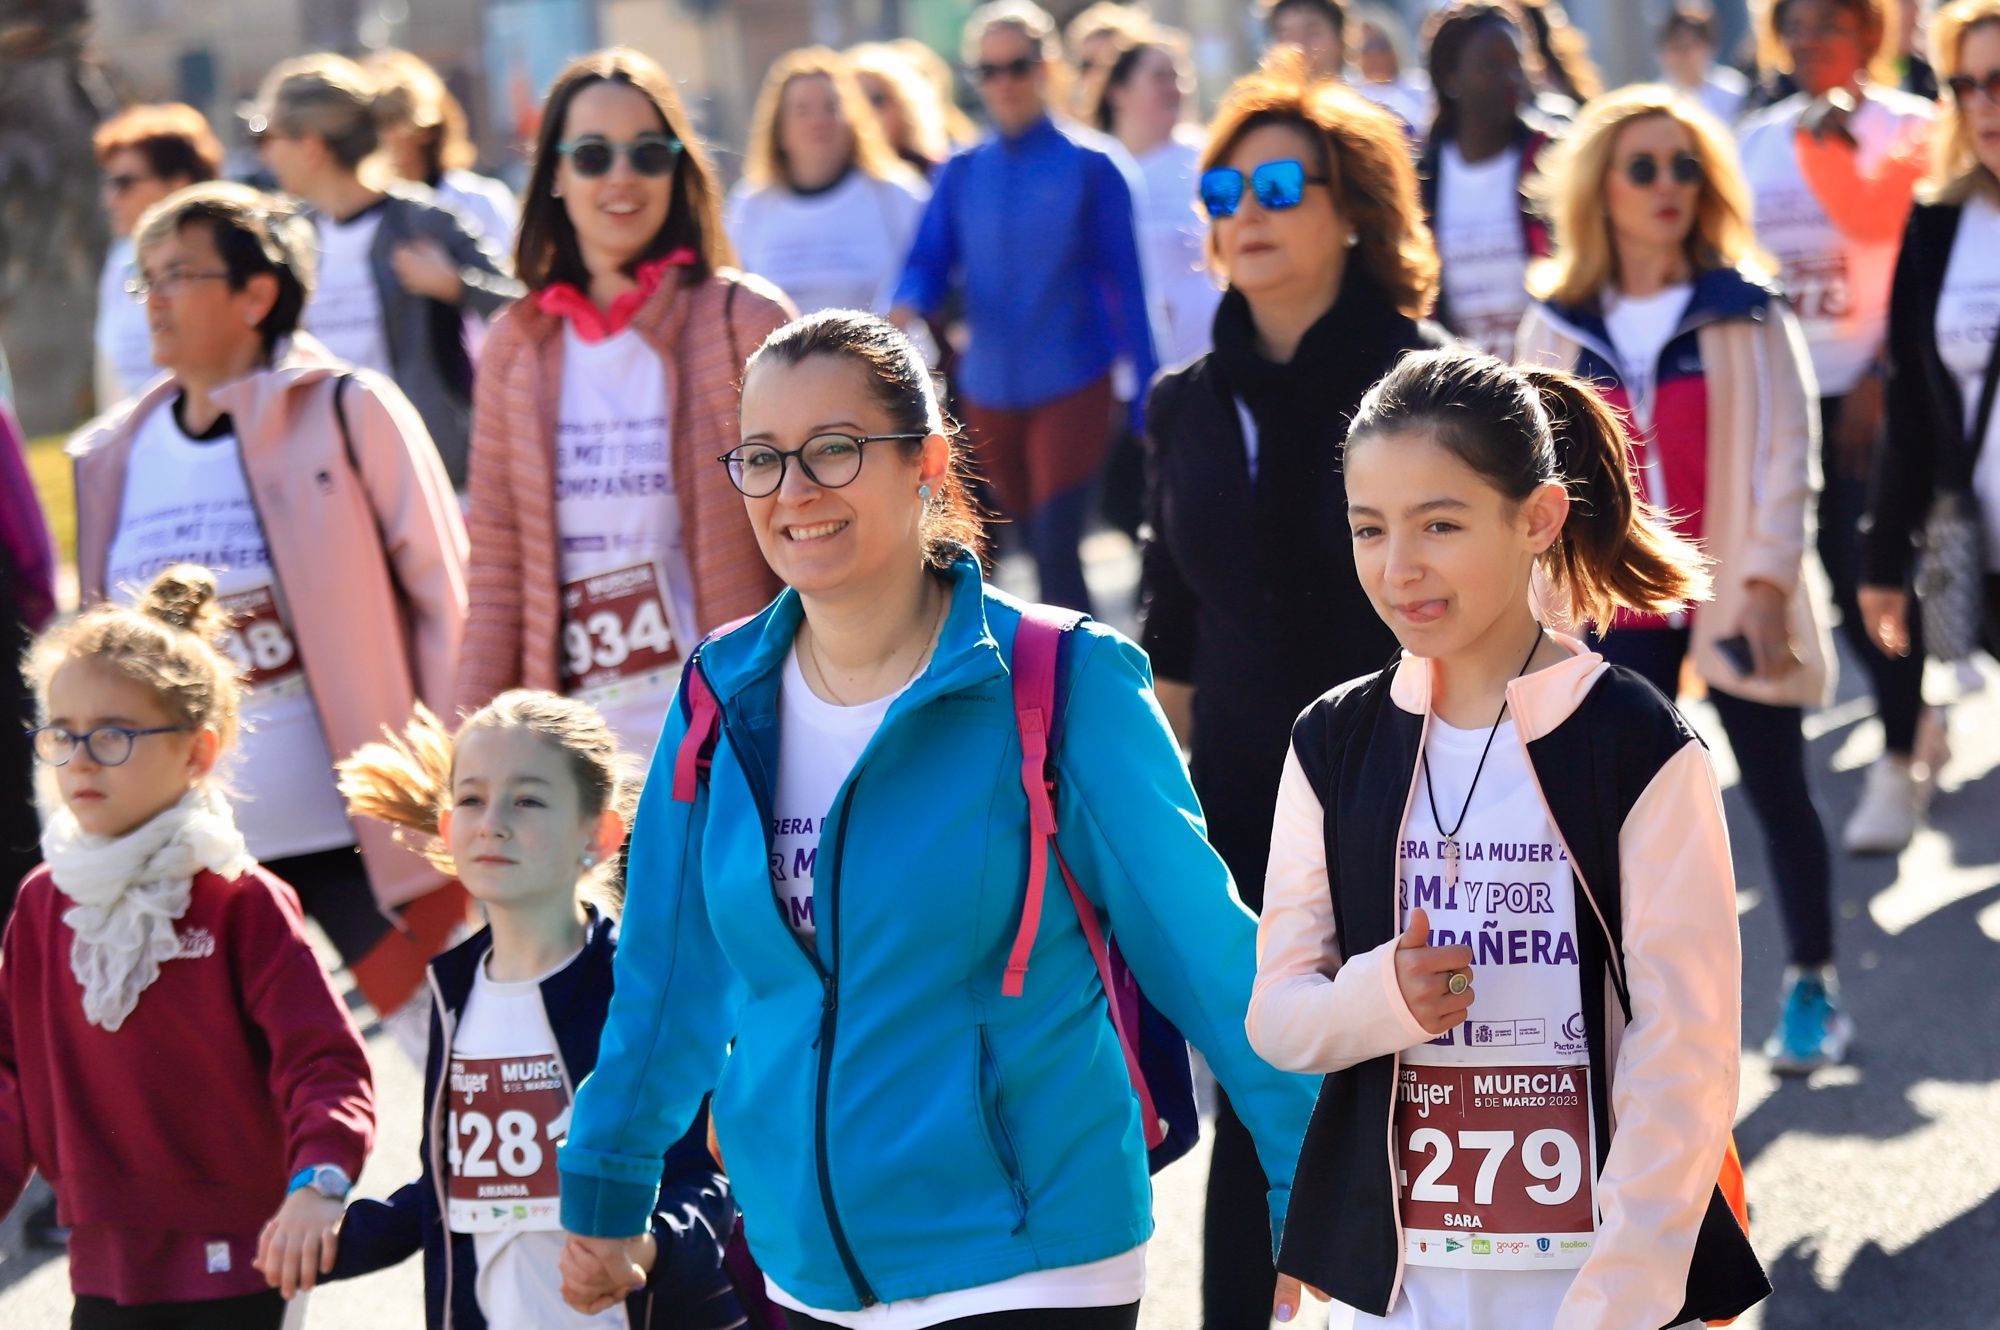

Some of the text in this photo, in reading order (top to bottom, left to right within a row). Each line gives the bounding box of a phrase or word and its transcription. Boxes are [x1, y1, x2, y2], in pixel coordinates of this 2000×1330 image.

[1465, 843, 1483, 861] LA
[1489, 843, 1553, 862] MUJER
[1464, 881, 1483, 912] Y
[1486, 882, 1554, 913] POR
[1427, 920, 1579, 965] PAÑERA
[1554, 1041, 1575, 1051] Pacto
[1473, 1073, 1576, 1095] MURCIA
[1474, 1096, 1578, 1108] 5 DE MARZO 2023
[477, 1183, 530, 1198] AMANDA
[1443, 1213, 1483, 1228] SARA
